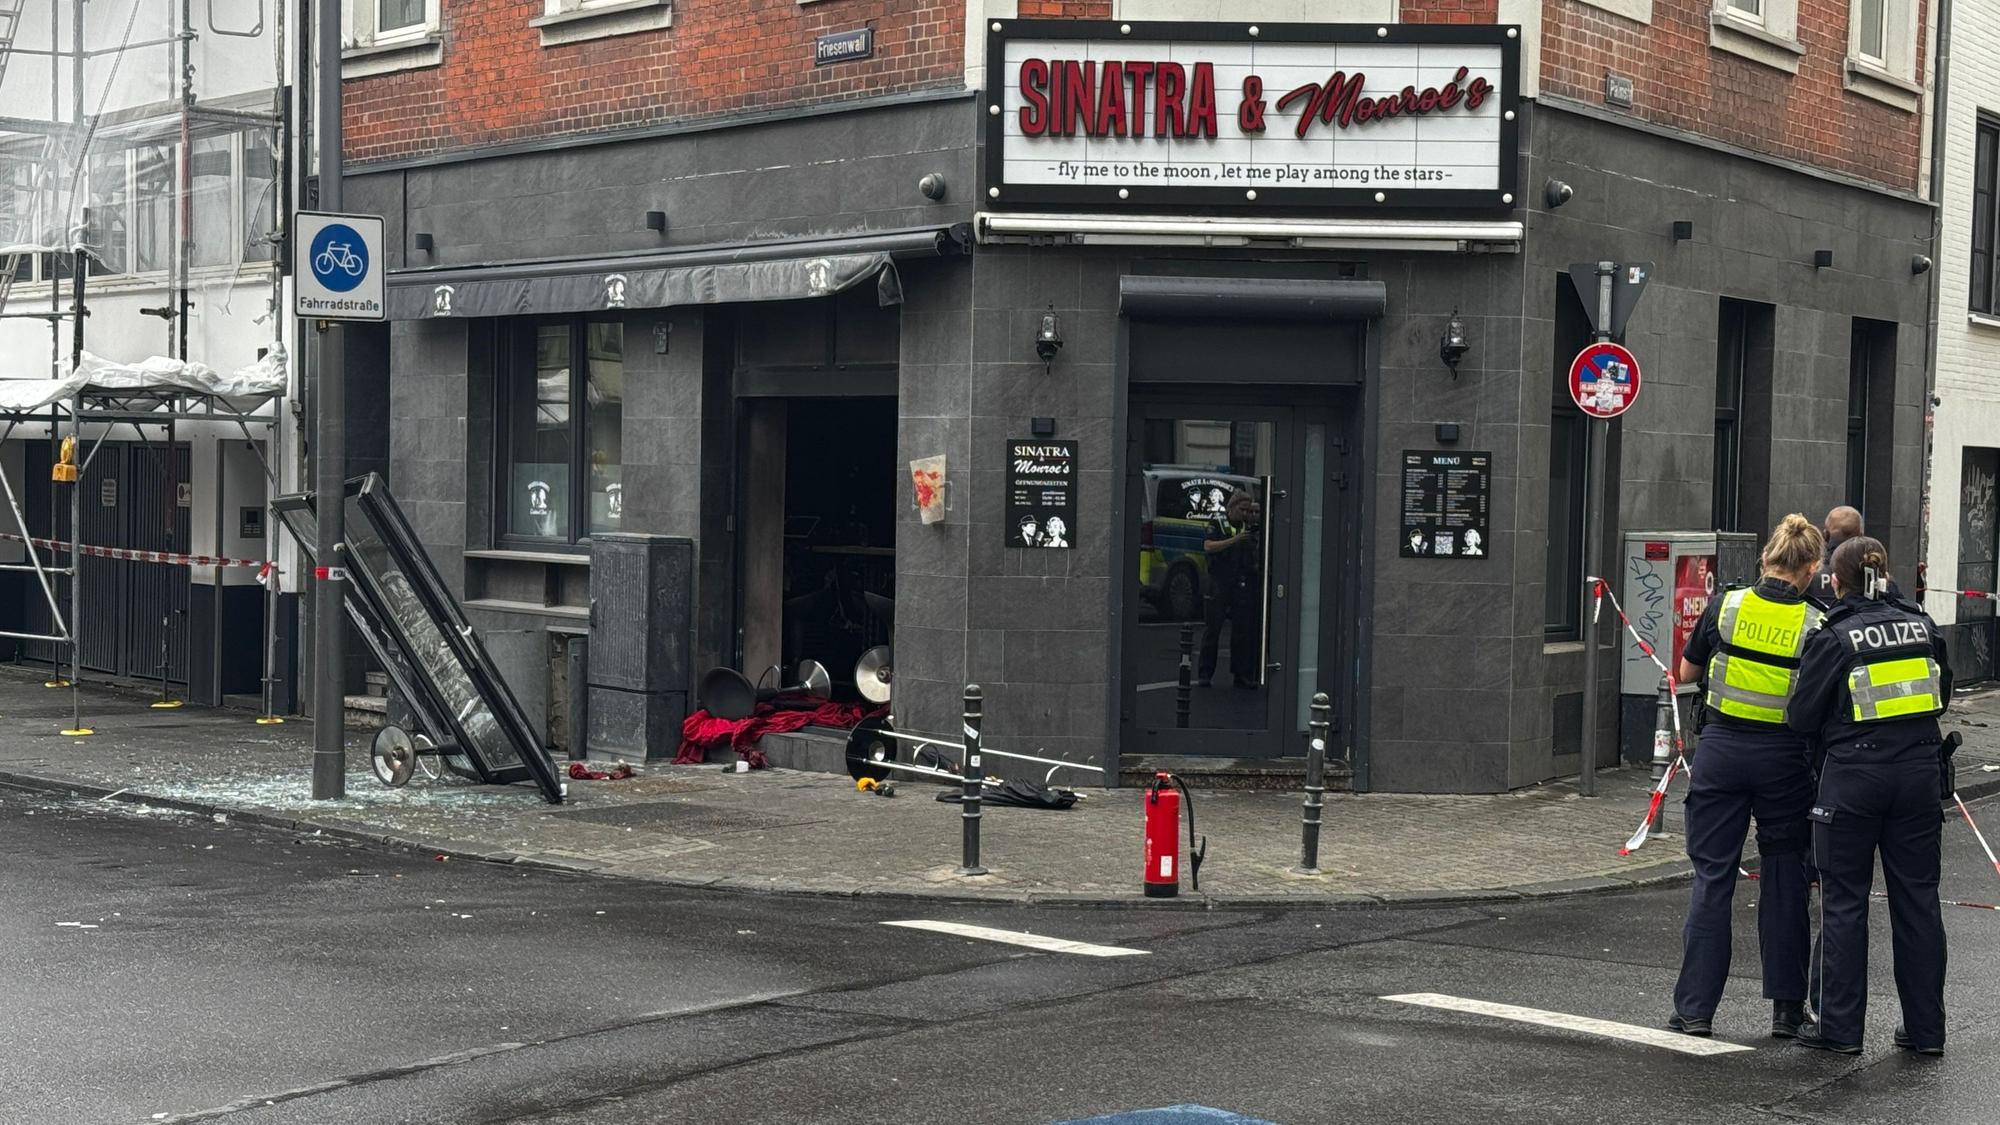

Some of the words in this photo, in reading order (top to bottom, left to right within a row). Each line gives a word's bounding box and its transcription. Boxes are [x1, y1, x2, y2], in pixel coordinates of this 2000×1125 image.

[818, 34, 865, 58] Friesenwall
[1019, 58, 1218, 138] SINATRA
[1238, 75, 1266, 132] &
[1084, 166, 1108, 177] me
[1114, 164, 1129, 177] to
[1134, 162, 1159, 177] the
[1246, 167, 1271, 179] me
[1276, 164, 1309, 182] play
[1313, 168, 1369, 183] among
[1374, 165, 1399, 180] the
[300, 296, 380, 311] Fahrradstraße
[1014, 445, 1070, 457] SINATRA
[1013, 459, 1070, 475] Monroe's
[1736, 619, 1797, 649] POLIZEI
[1848, 621, 1929, 652] POLIZEI
